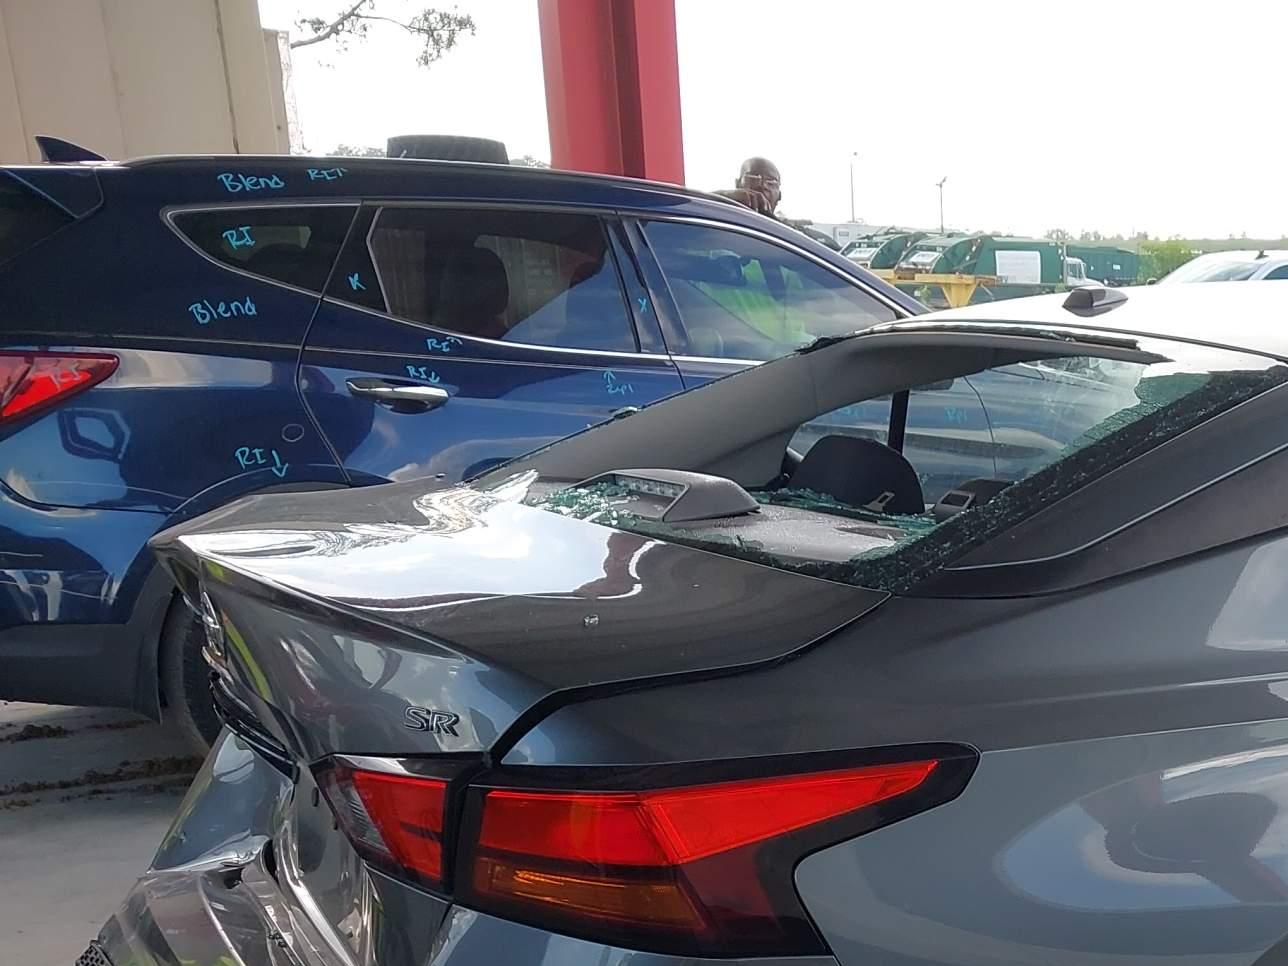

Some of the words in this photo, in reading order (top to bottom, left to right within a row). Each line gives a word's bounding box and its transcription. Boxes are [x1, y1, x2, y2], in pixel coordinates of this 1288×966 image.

[217, 172, 285, 193] Blend
[222, 226, 256, 250] RI
[187, 295, 258, 325] Blend
[234, 446, 267, 470] RI
[403, 705, 460, 738] SR
